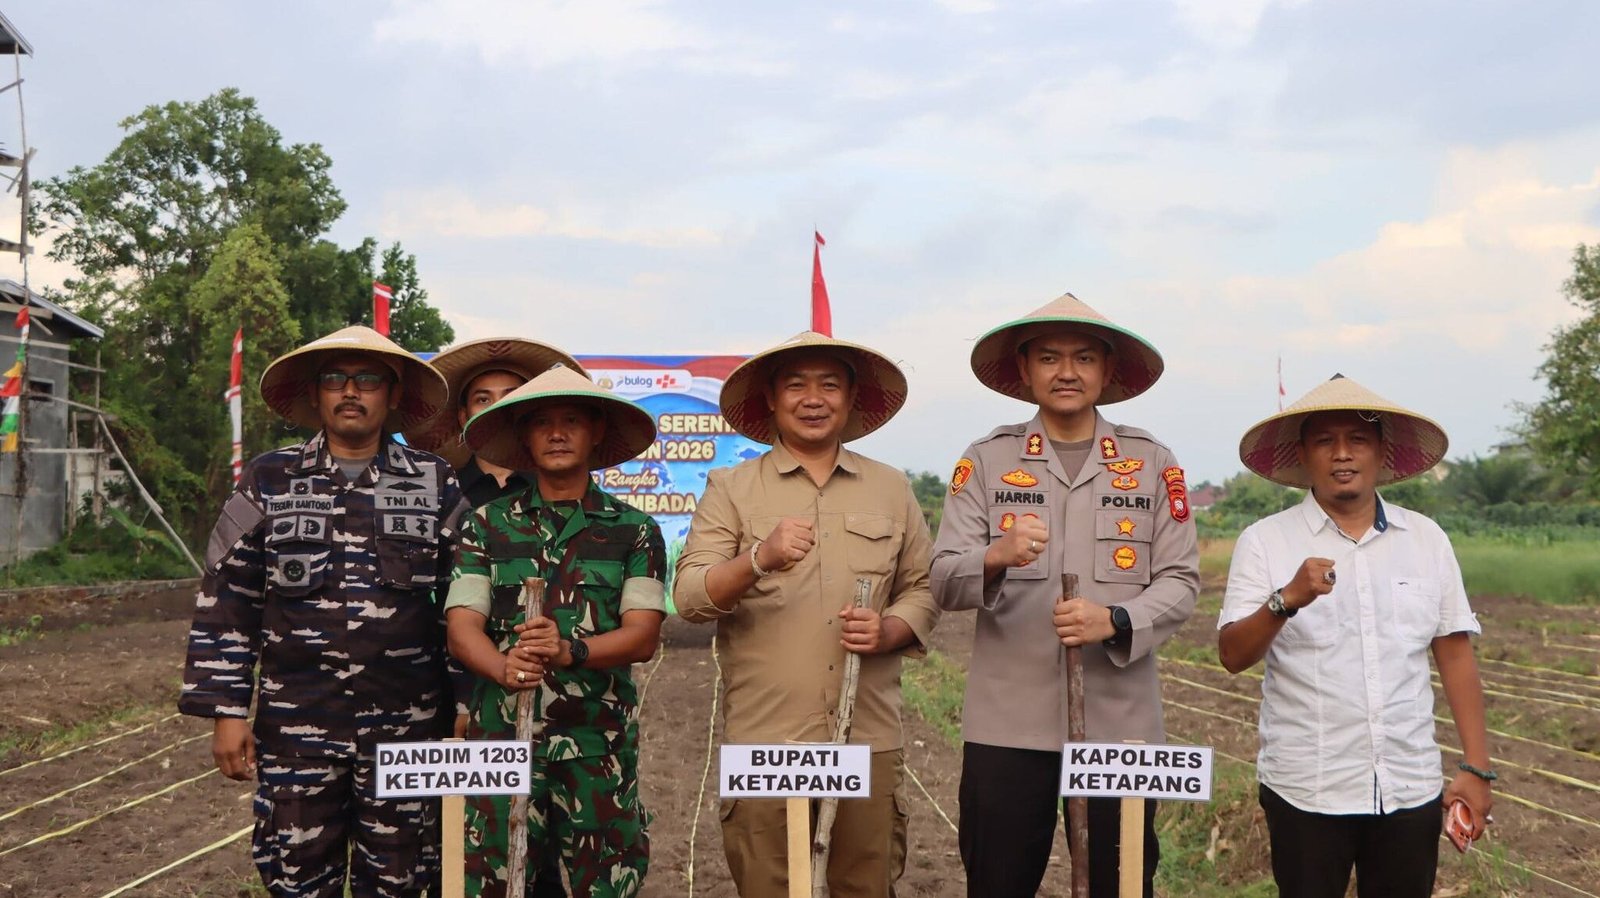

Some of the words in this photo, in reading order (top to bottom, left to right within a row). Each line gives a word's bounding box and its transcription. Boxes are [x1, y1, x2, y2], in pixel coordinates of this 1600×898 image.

[624, 376, 652, 388] bulog
[659, 414, 737, 433] SEREN
[665, 441, 714, 459] 2026
[604, 469, 657, 490] Rangka
[270, 500, 293, 511] TEGUH
[295, 500, 331, 511] SANTOSO
[384, 496, 408, 507] TNI
[414, 497, 431, 508] AL
[994, 491, 1045, 505] HARRIS
[1101, 495, 1150, 510] POLRI
[379, 748, 471, 766] DANDIM
[479, 747, 529, 764] 1203
[751, 750, 839, 767] BUPATI
[1070, 748, 1203, 769] KAPOLRES
[385, 771, 520, 790] KETAPANG
[728, 774, 861, 791] KETAPANG
[1069, 773, 1201, 793] KETAPANG
